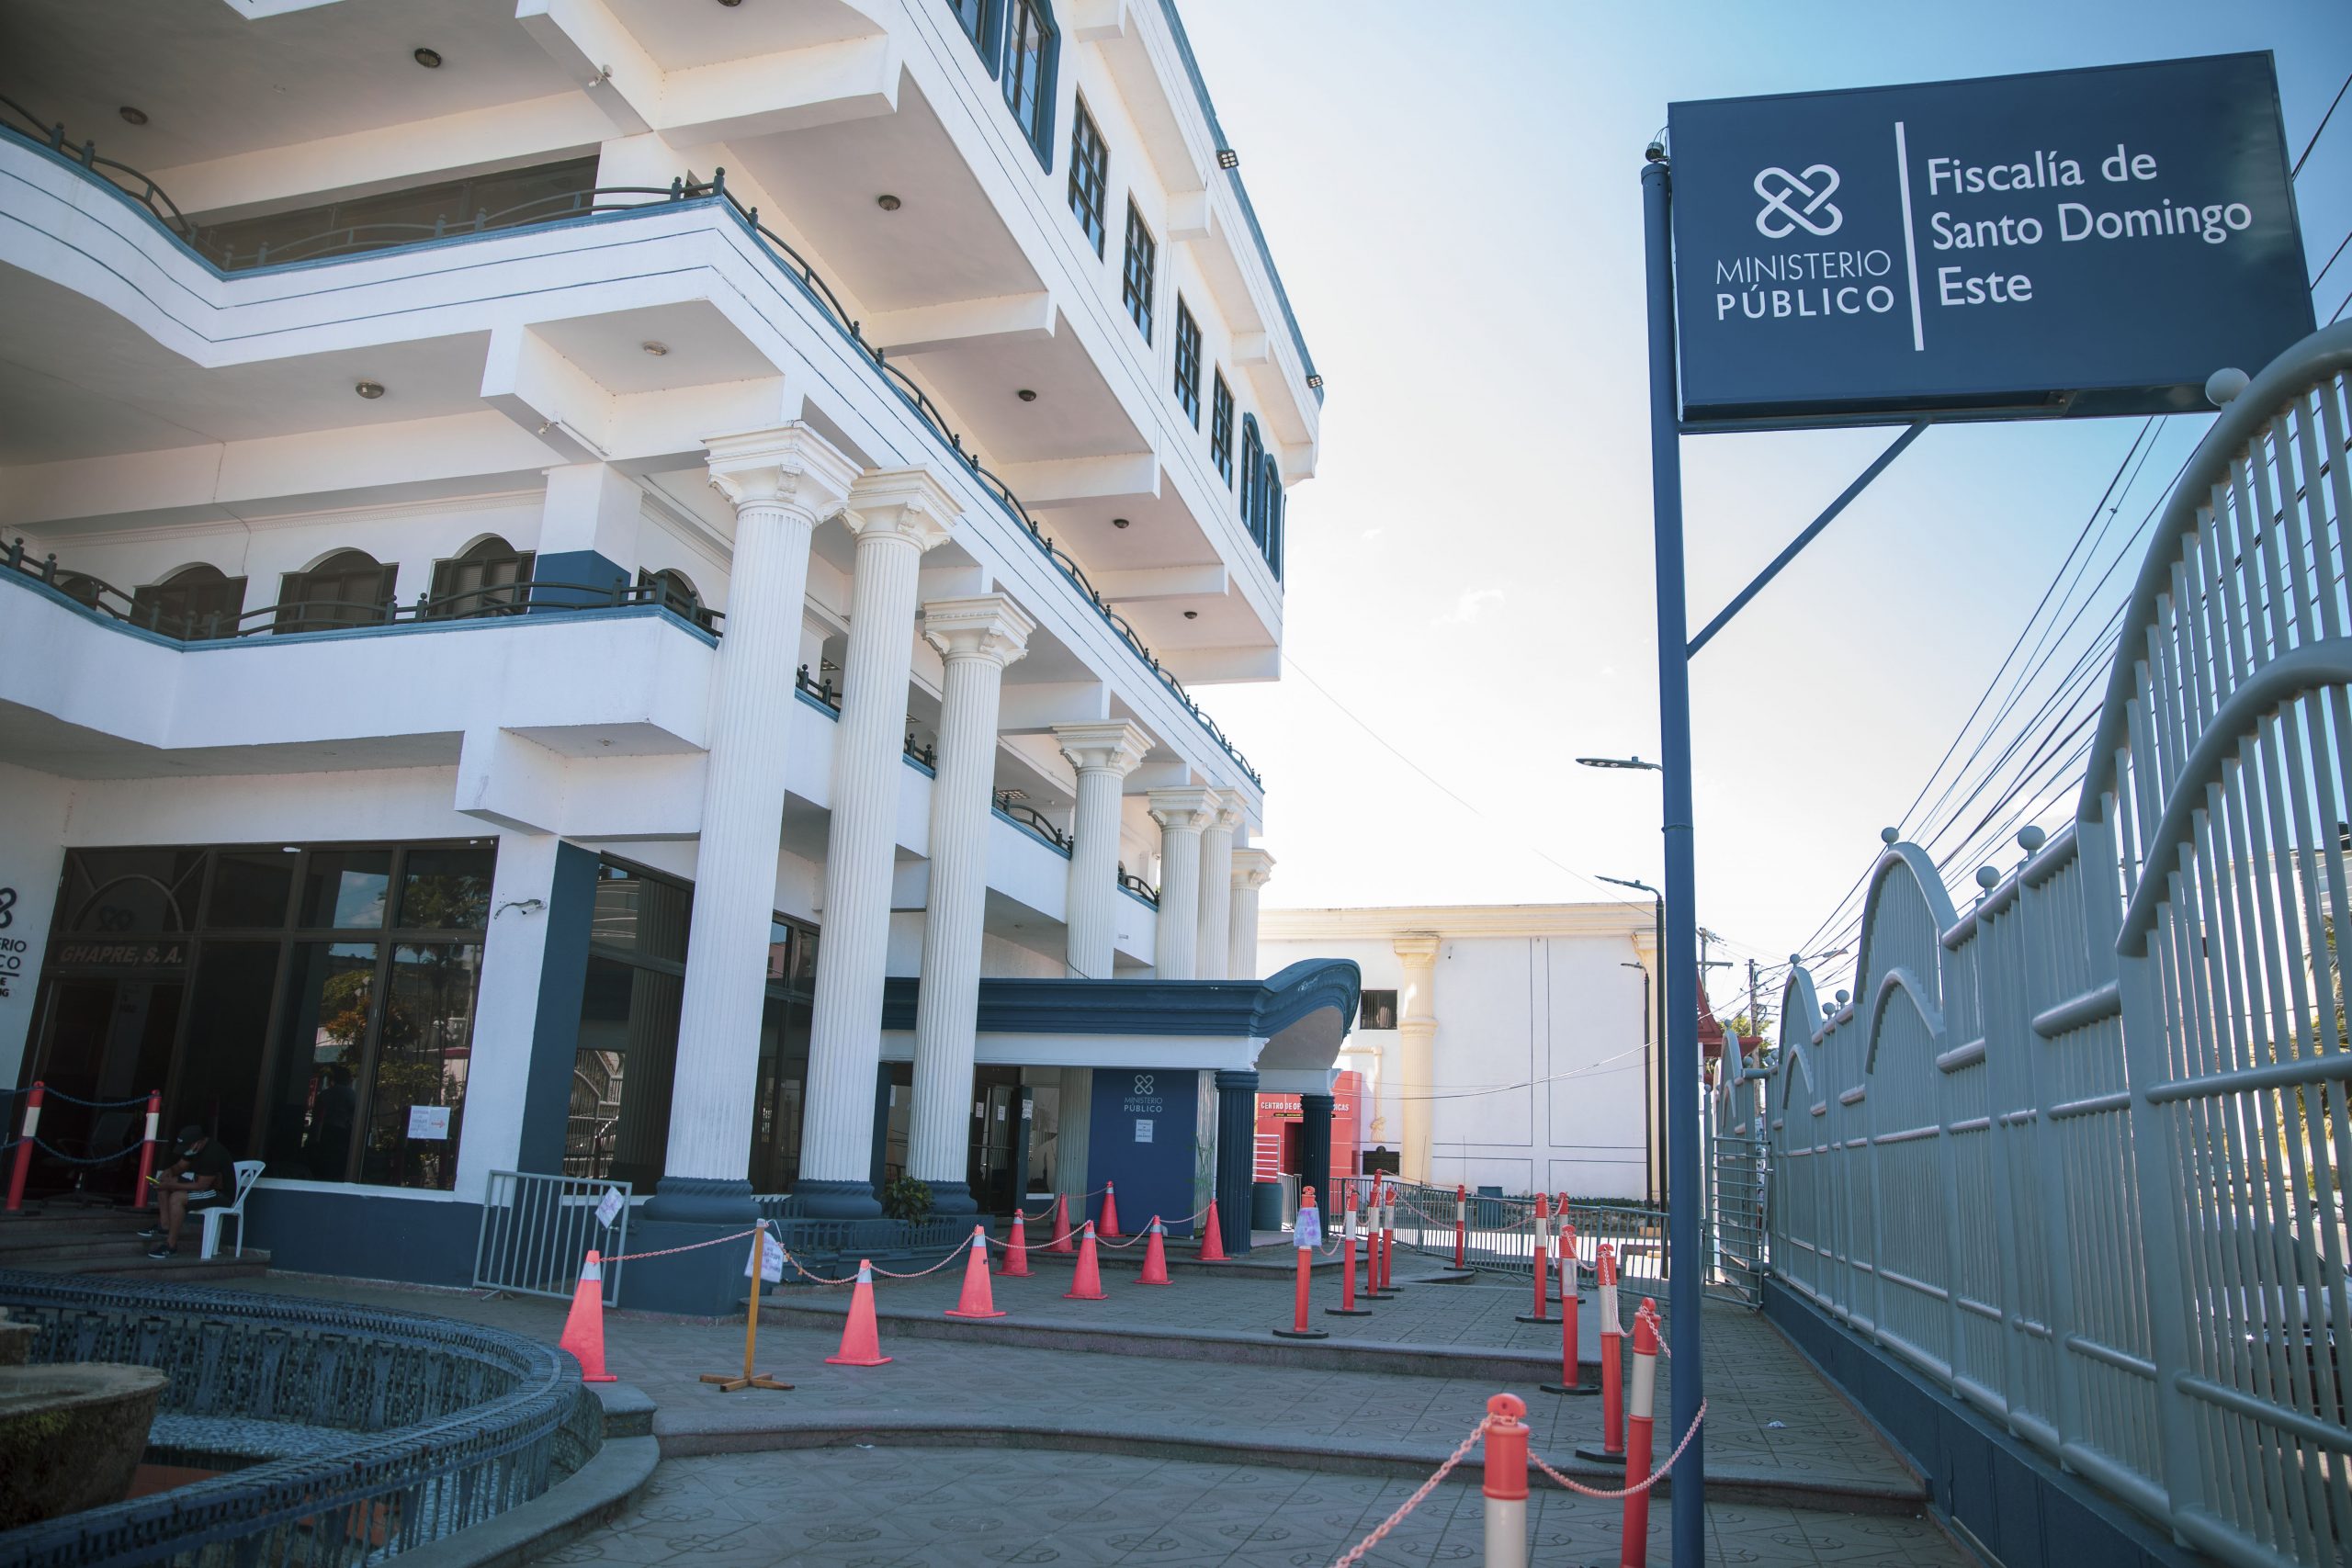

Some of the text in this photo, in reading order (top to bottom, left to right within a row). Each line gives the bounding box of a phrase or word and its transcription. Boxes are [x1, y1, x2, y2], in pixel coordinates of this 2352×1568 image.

[1928, 143, 2157, 196] Fiscalía de
[1931, 198, 2252, 250] Santo Domingo
[1716, 249, 1891, 285] MINISTERIO
[1716, 285, 1894, 321] PÚBLICO
[1938, 265, 2032, 306] Este
[0, 937, 27, 953] RIO
[59, 946, 140, 966] GHAPRE,
[163, 945, 184, 964] A.
[1124, 1103, 1162, 1113] PÚBLICO
[1261, 1101, 1284, 1110] CENTRO
[1284, 1102, 1293, 1111] DE
